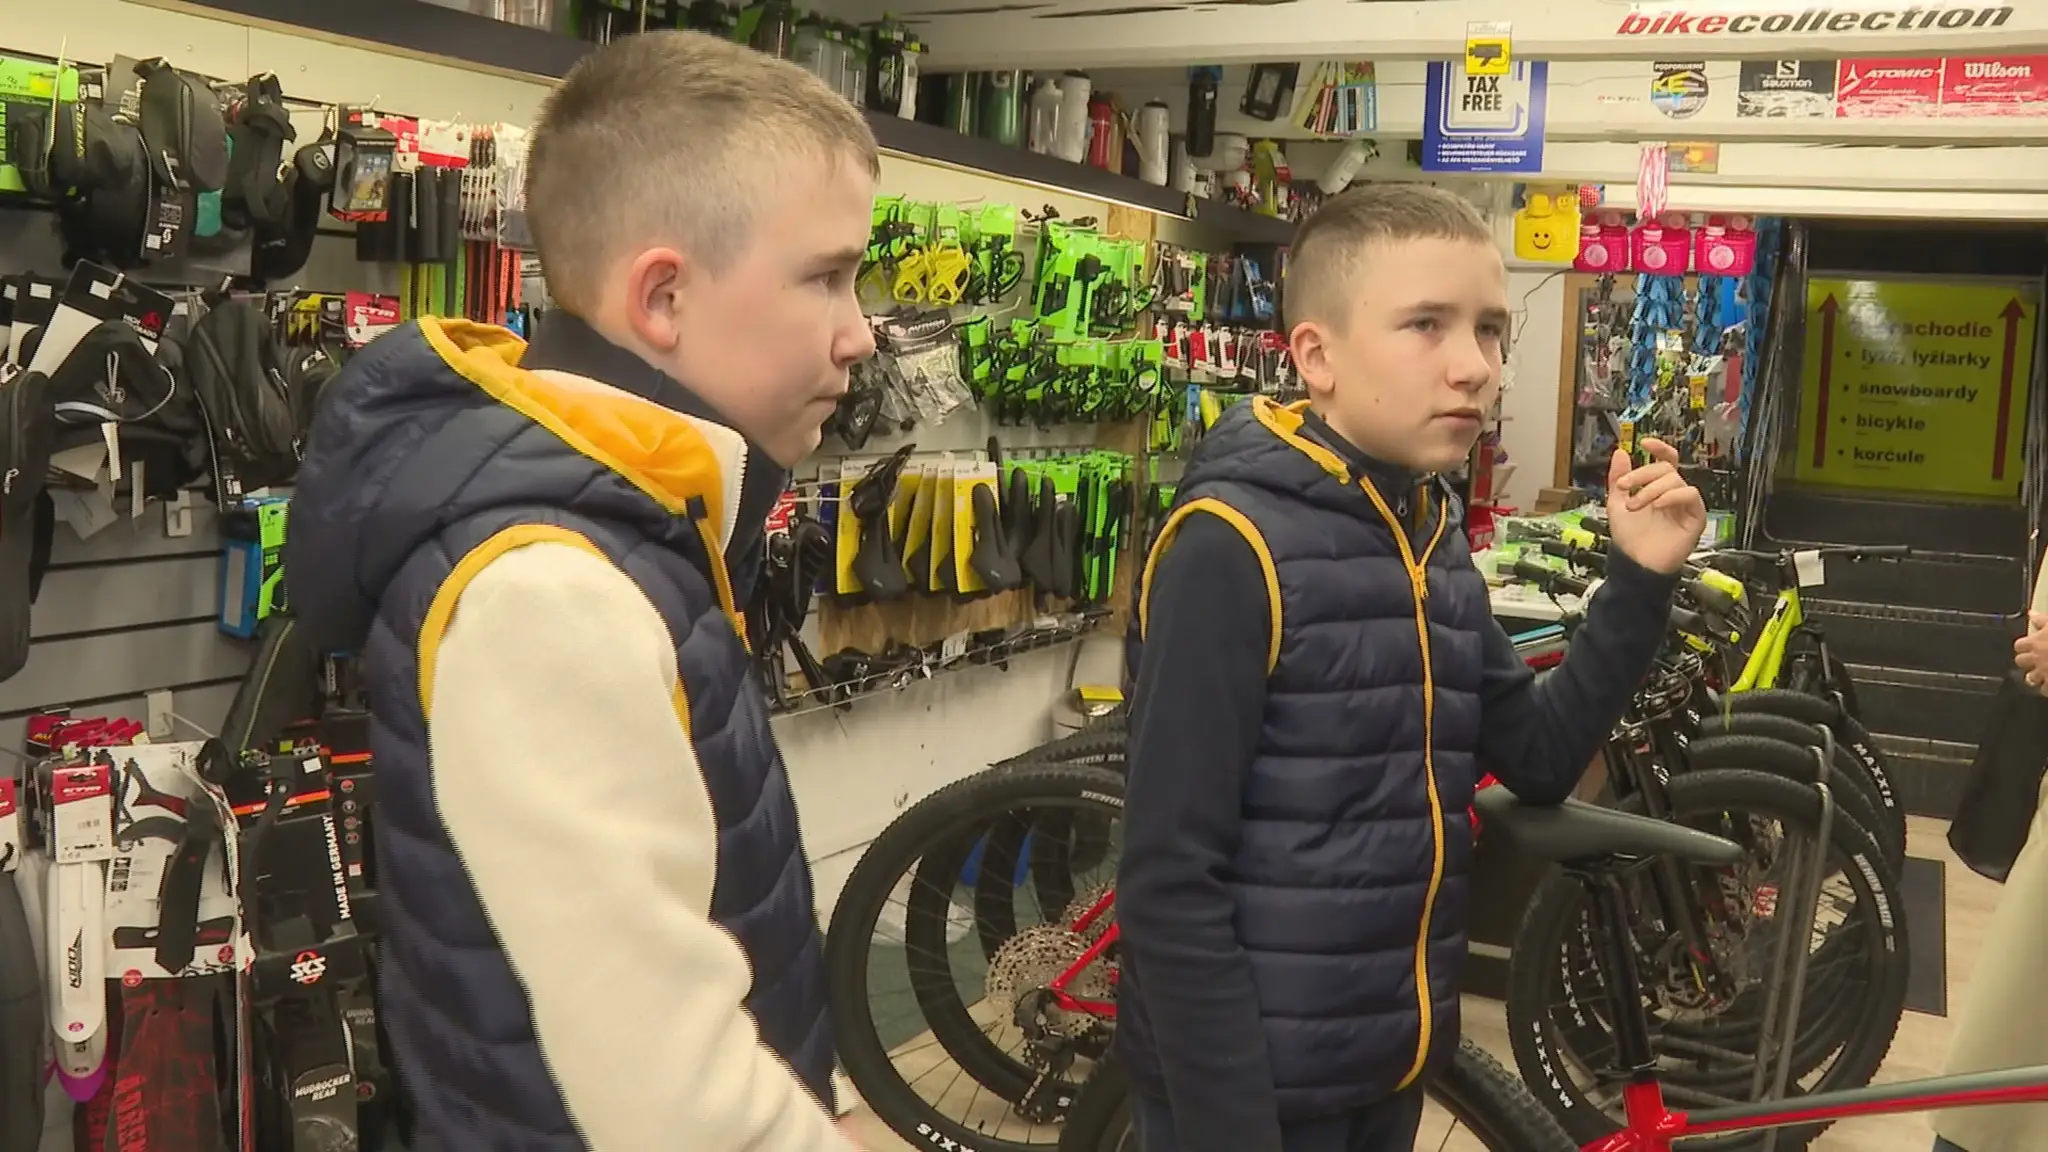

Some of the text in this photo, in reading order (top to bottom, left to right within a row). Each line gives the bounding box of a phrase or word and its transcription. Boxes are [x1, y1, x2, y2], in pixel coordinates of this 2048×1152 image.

[1617, 6, 2014, 35] bikecollection
[1864, 68, 1934, 79] ATOMIC
[1964, 61, 2031, 78] Wilson
[1467, 76, 1500, 93] TAX
[1462, 94, 1503, 112] FREE
[1859, 383, 1978, 402] snowboardy
[1856, 413, 1926, 432] bicykle
[1852, 743, 1895, 808] MAXXIS
[322, 815, 351, 920] MADE IN GERMANY
[1560, 942, 1587, 1027] MAXXIS
[1532, 1020, 1575, 1108] MAXXIS
[295, 1073, 351, 1098] MUDROCKER
[312, 1087, 336, 1102] REAR
